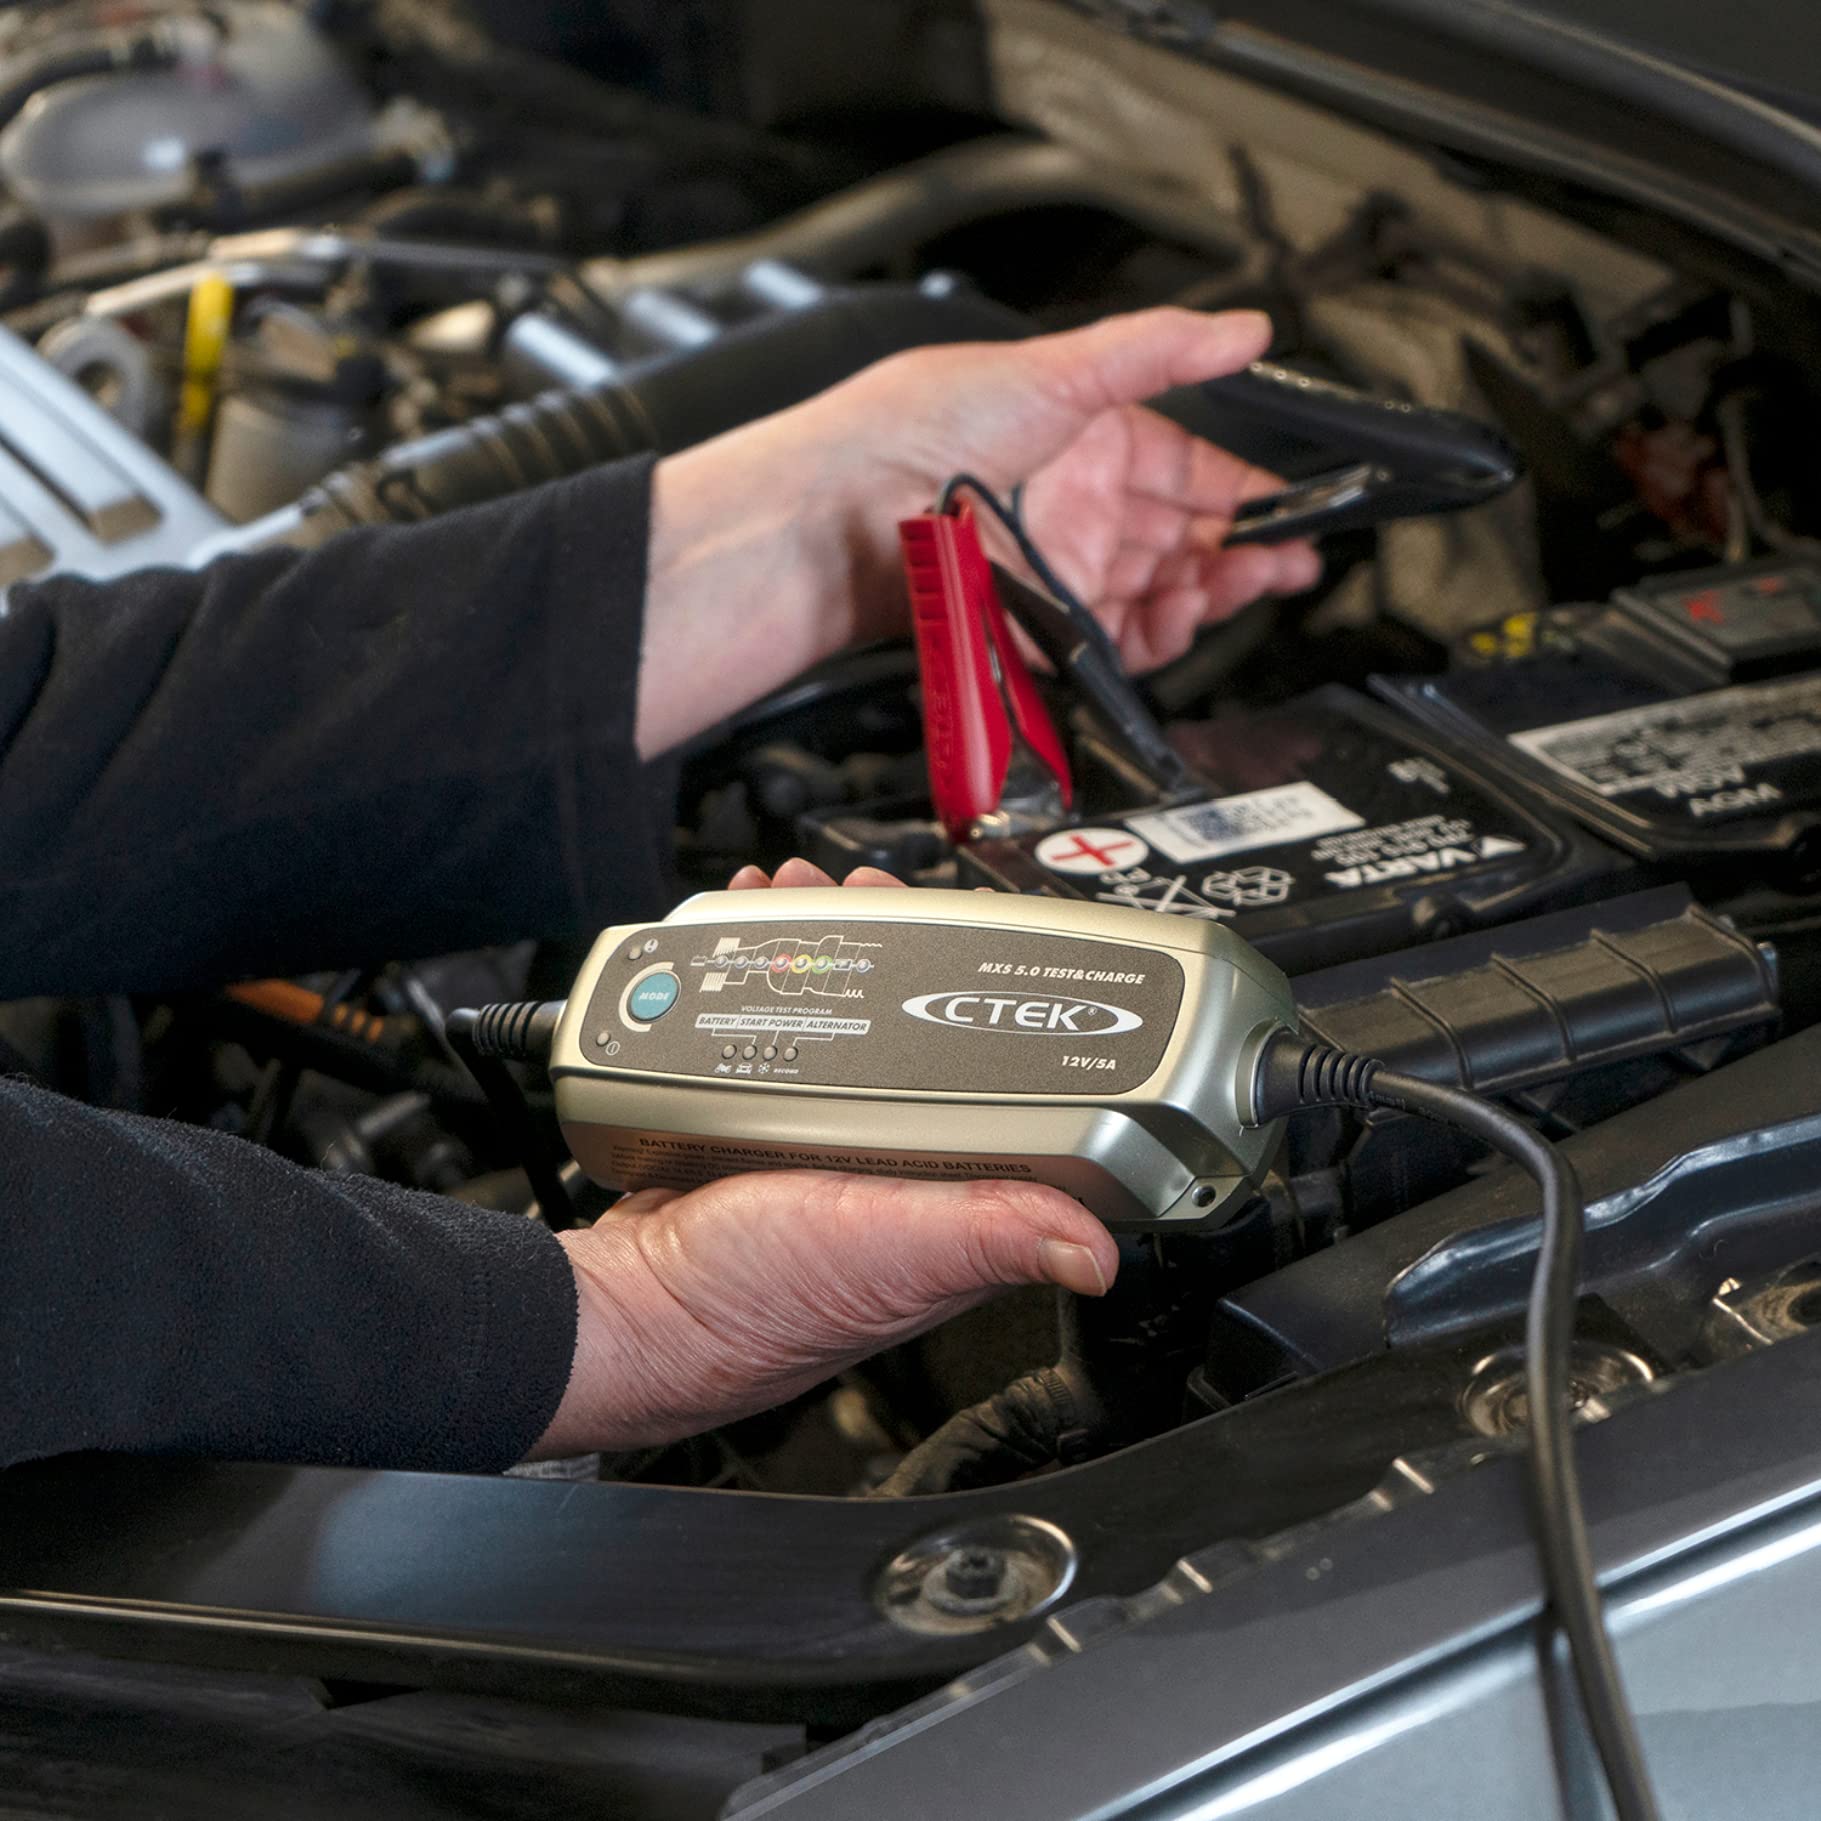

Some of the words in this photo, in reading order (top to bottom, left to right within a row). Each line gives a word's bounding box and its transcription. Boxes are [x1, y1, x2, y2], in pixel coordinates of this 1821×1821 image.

[1325, 847, 1477, 888] VARTA
[978, 962, 1012, 974] MXS
[1014, 965, 1040, 976] 5.0
[1042, 967, 1146, 985] TEST&CHARGE
[639, 992, 670, 1001] MODE
[741, 1005, 774, 1014] VOLTAGE
[698, 1016, 736, 1026] BATTERY
[740, 1017, 768, 1027] START
[768, 1019, 804, 1029] POWER
[806, 1020, 868, 1031] ALTERNATOR
[1061, 1055, 1116, 1070] 12V/5A
[639, 1138, 705, 1153] BATTERY
[710, 1146, 785, 1160] CHARGER
[789, 1153, 821, 1162] FOR
[826, 1155, 850, 1164] 12V
[856, 1157, 898, 1168] LEAD
[902, 1159, 939, 1170] ACID
[943, 1162, 1032, 1174] BATTERIES
